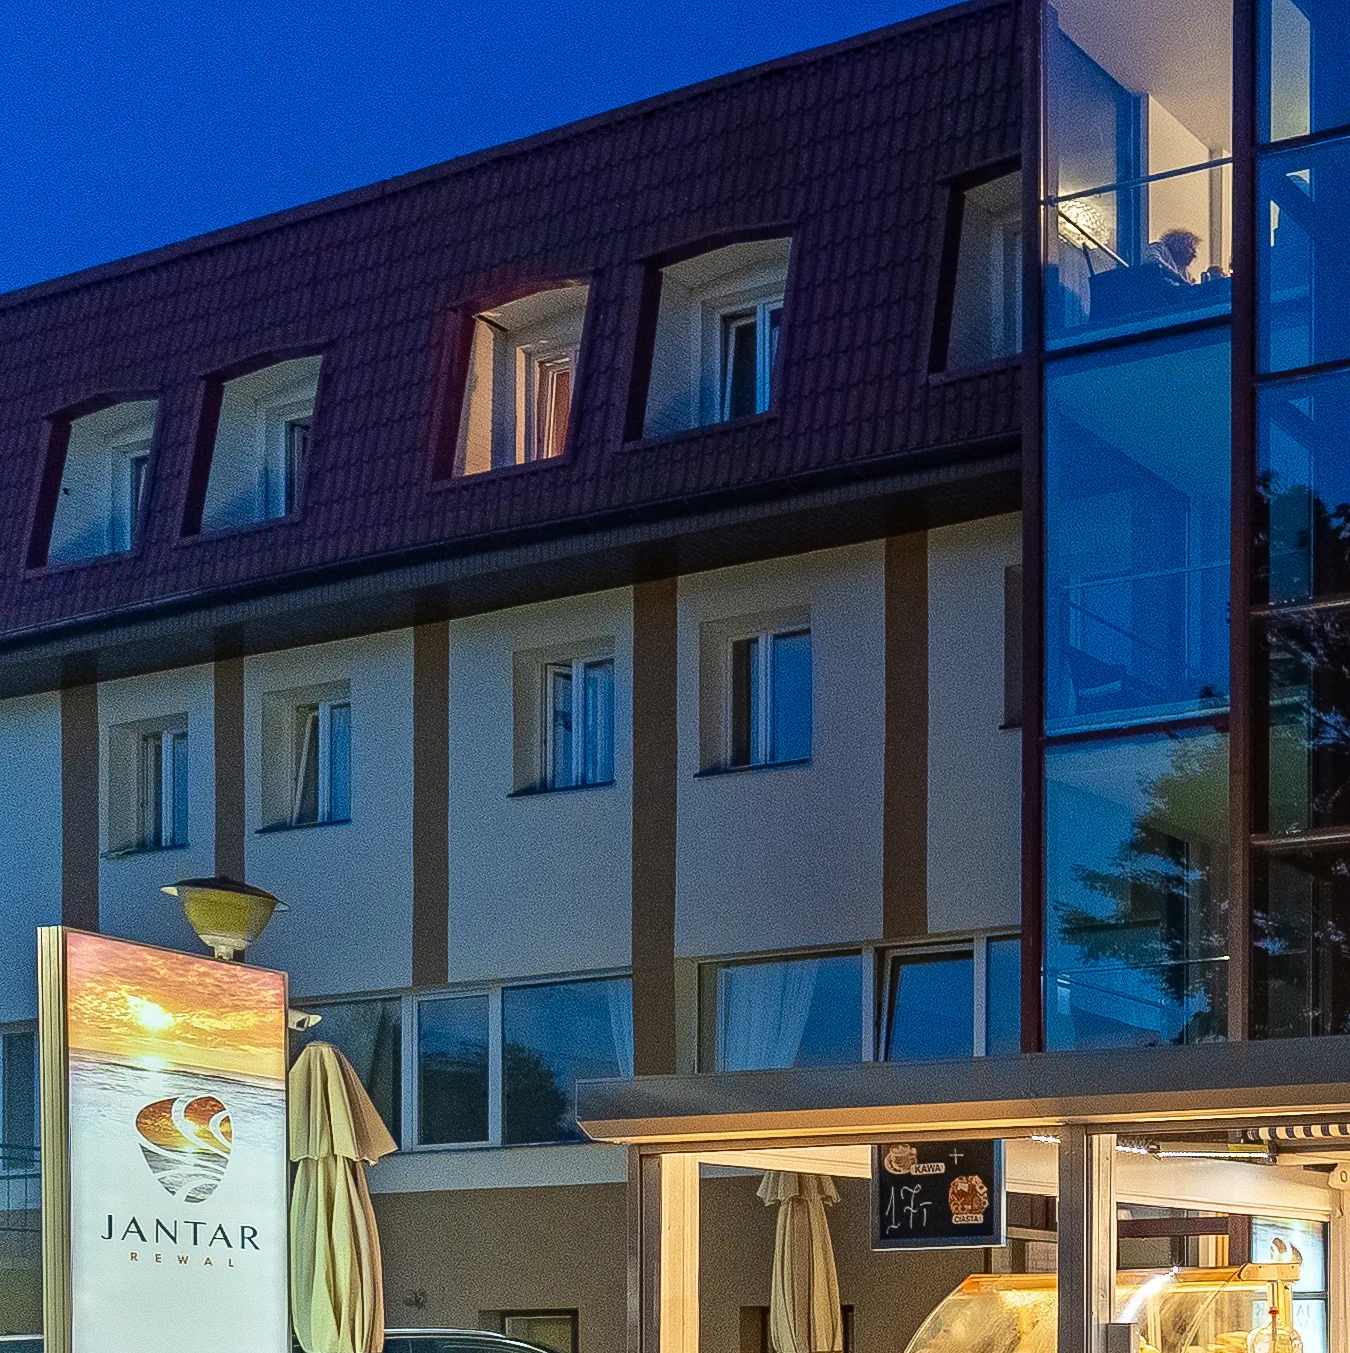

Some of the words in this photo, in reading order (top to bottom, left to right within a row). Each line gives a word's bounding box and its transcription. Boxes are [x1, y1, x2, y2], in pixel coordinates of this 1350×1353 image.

[914, 1163, 941, 1174] KAWA
[100, 1214, 261, 1251] JANTAR
[129, 1251, 235, 1268] REWAL
